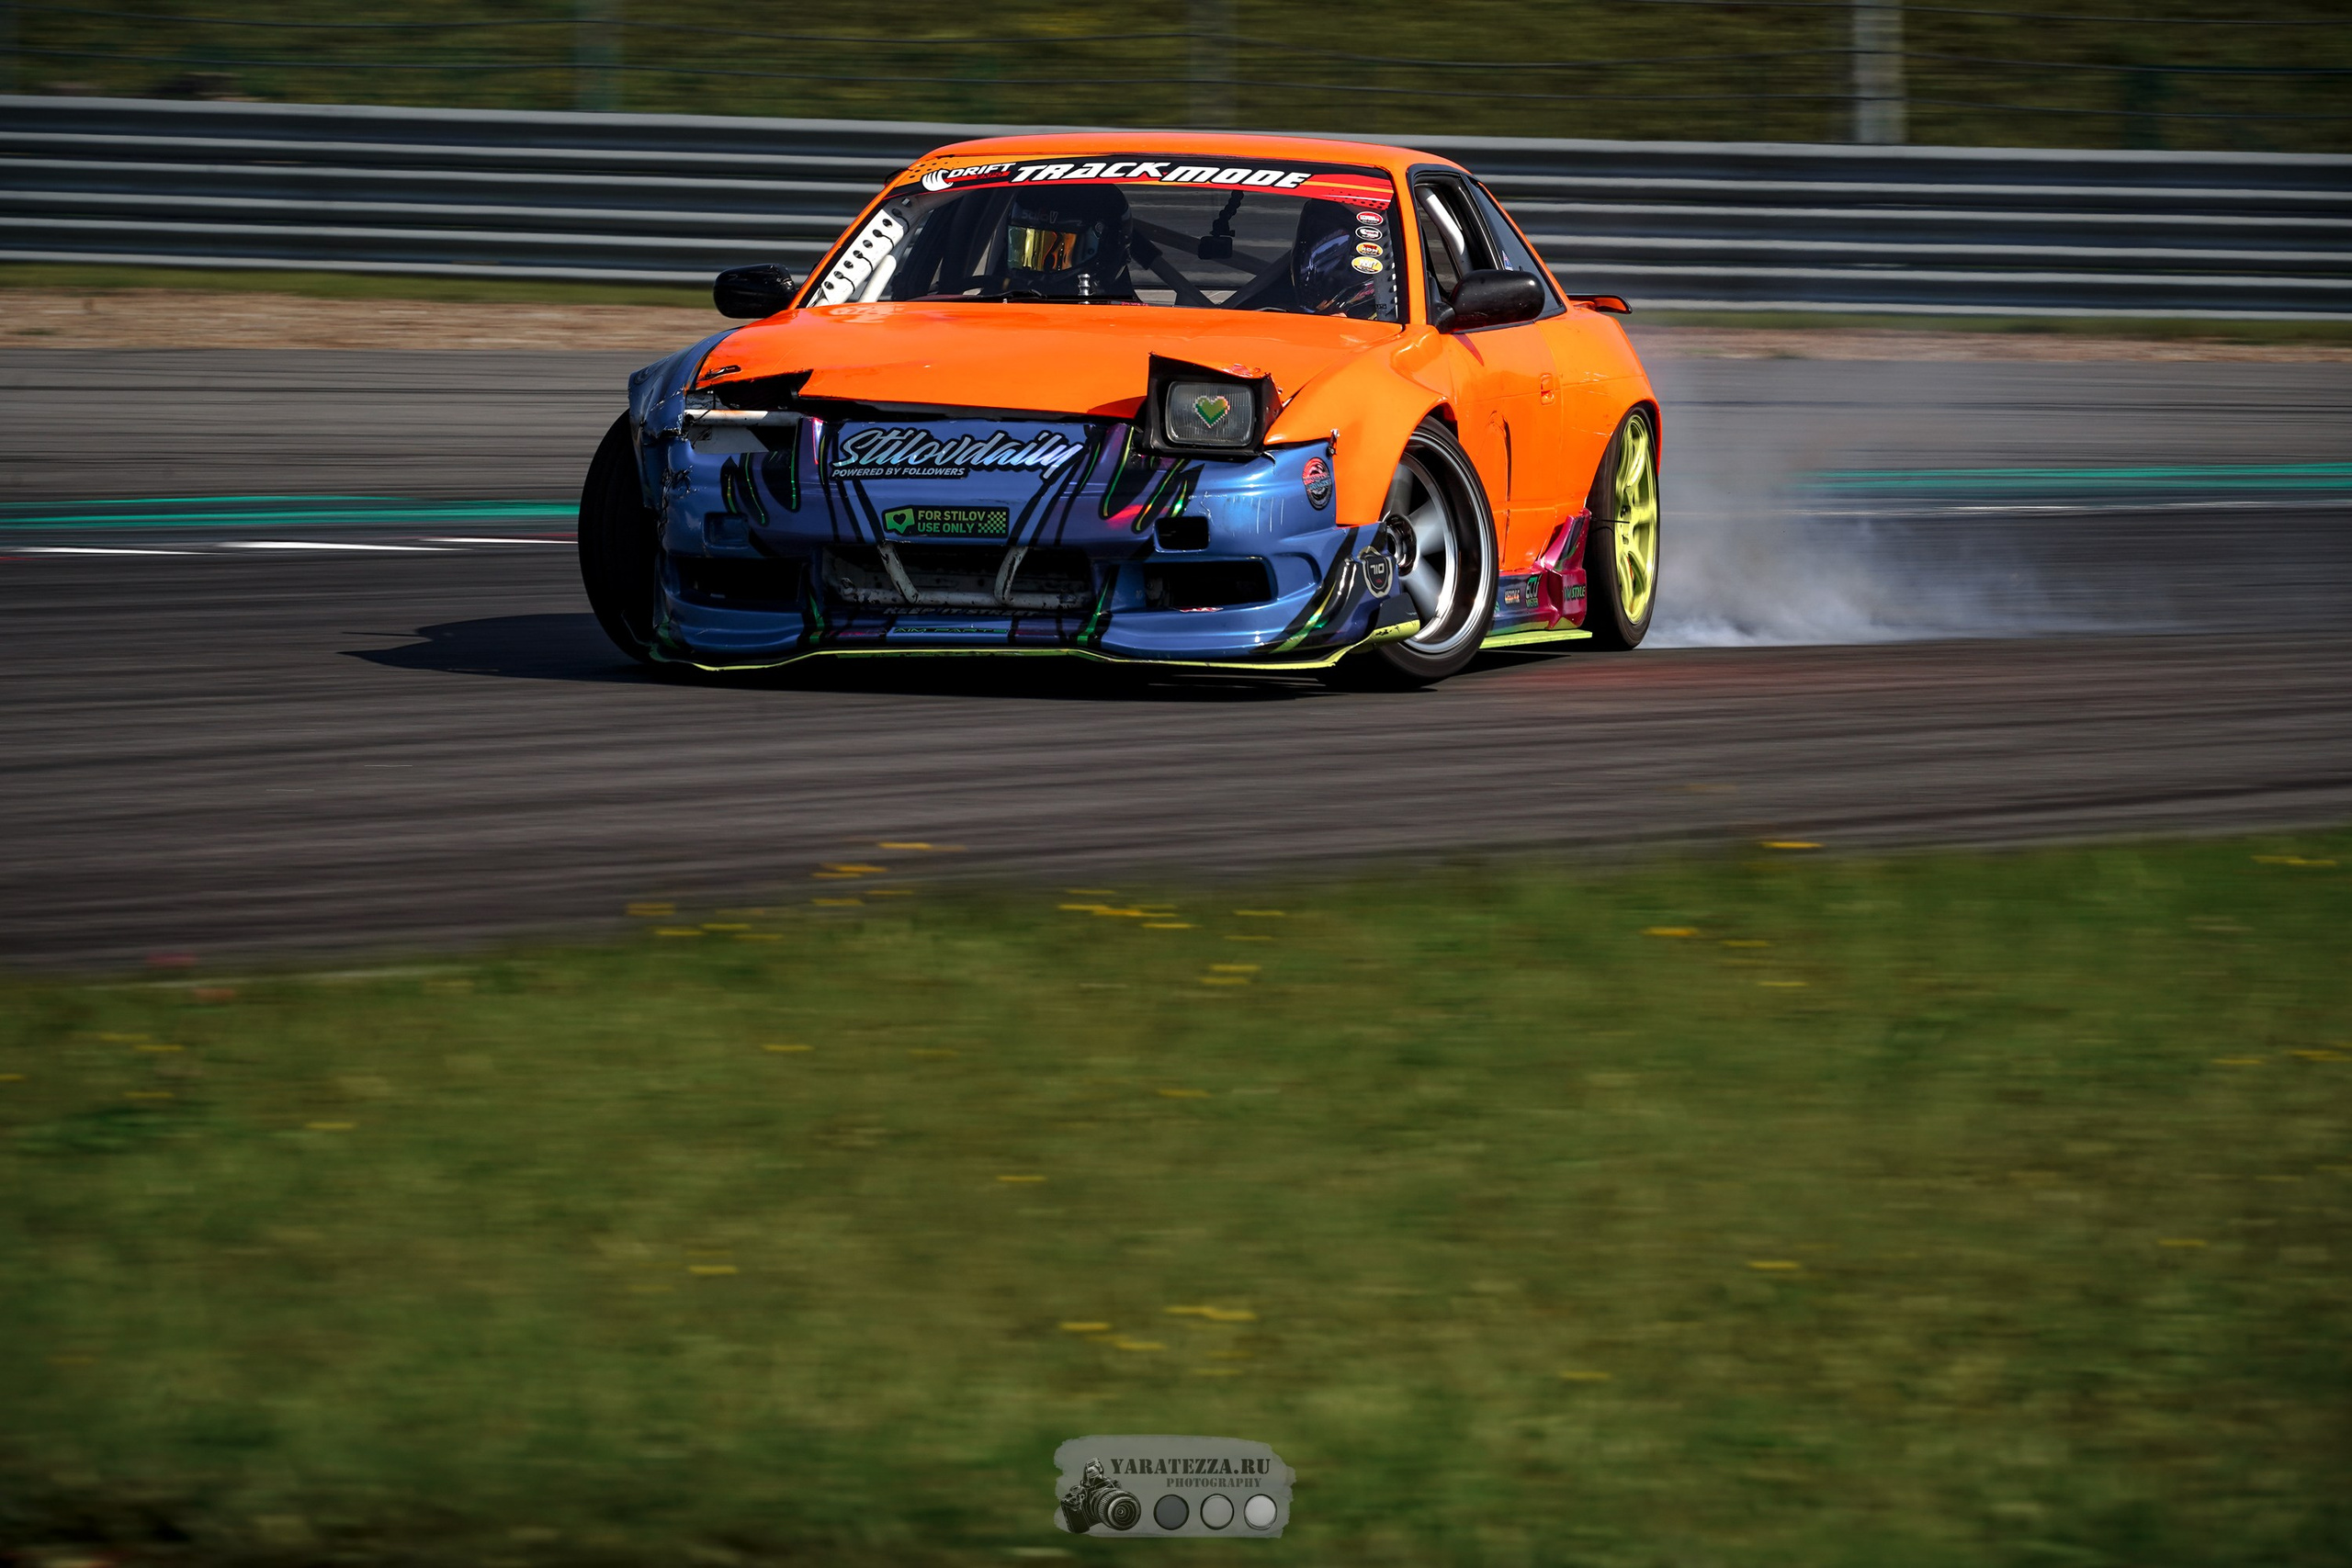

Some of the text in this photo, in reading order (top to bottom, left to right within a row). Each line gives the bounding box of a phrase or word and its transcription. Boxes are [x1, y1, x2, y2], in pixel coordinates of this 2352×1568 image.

[947, 163, 1017, 178] DRIFT
[831, 468, 965, 477] POWERED BY FOLLOWERS
[918, 511, 986, 522] FOR STILOV
[918, 523, 975, 534] USE ONLY
[966, 608, 1040, 616] STREET
